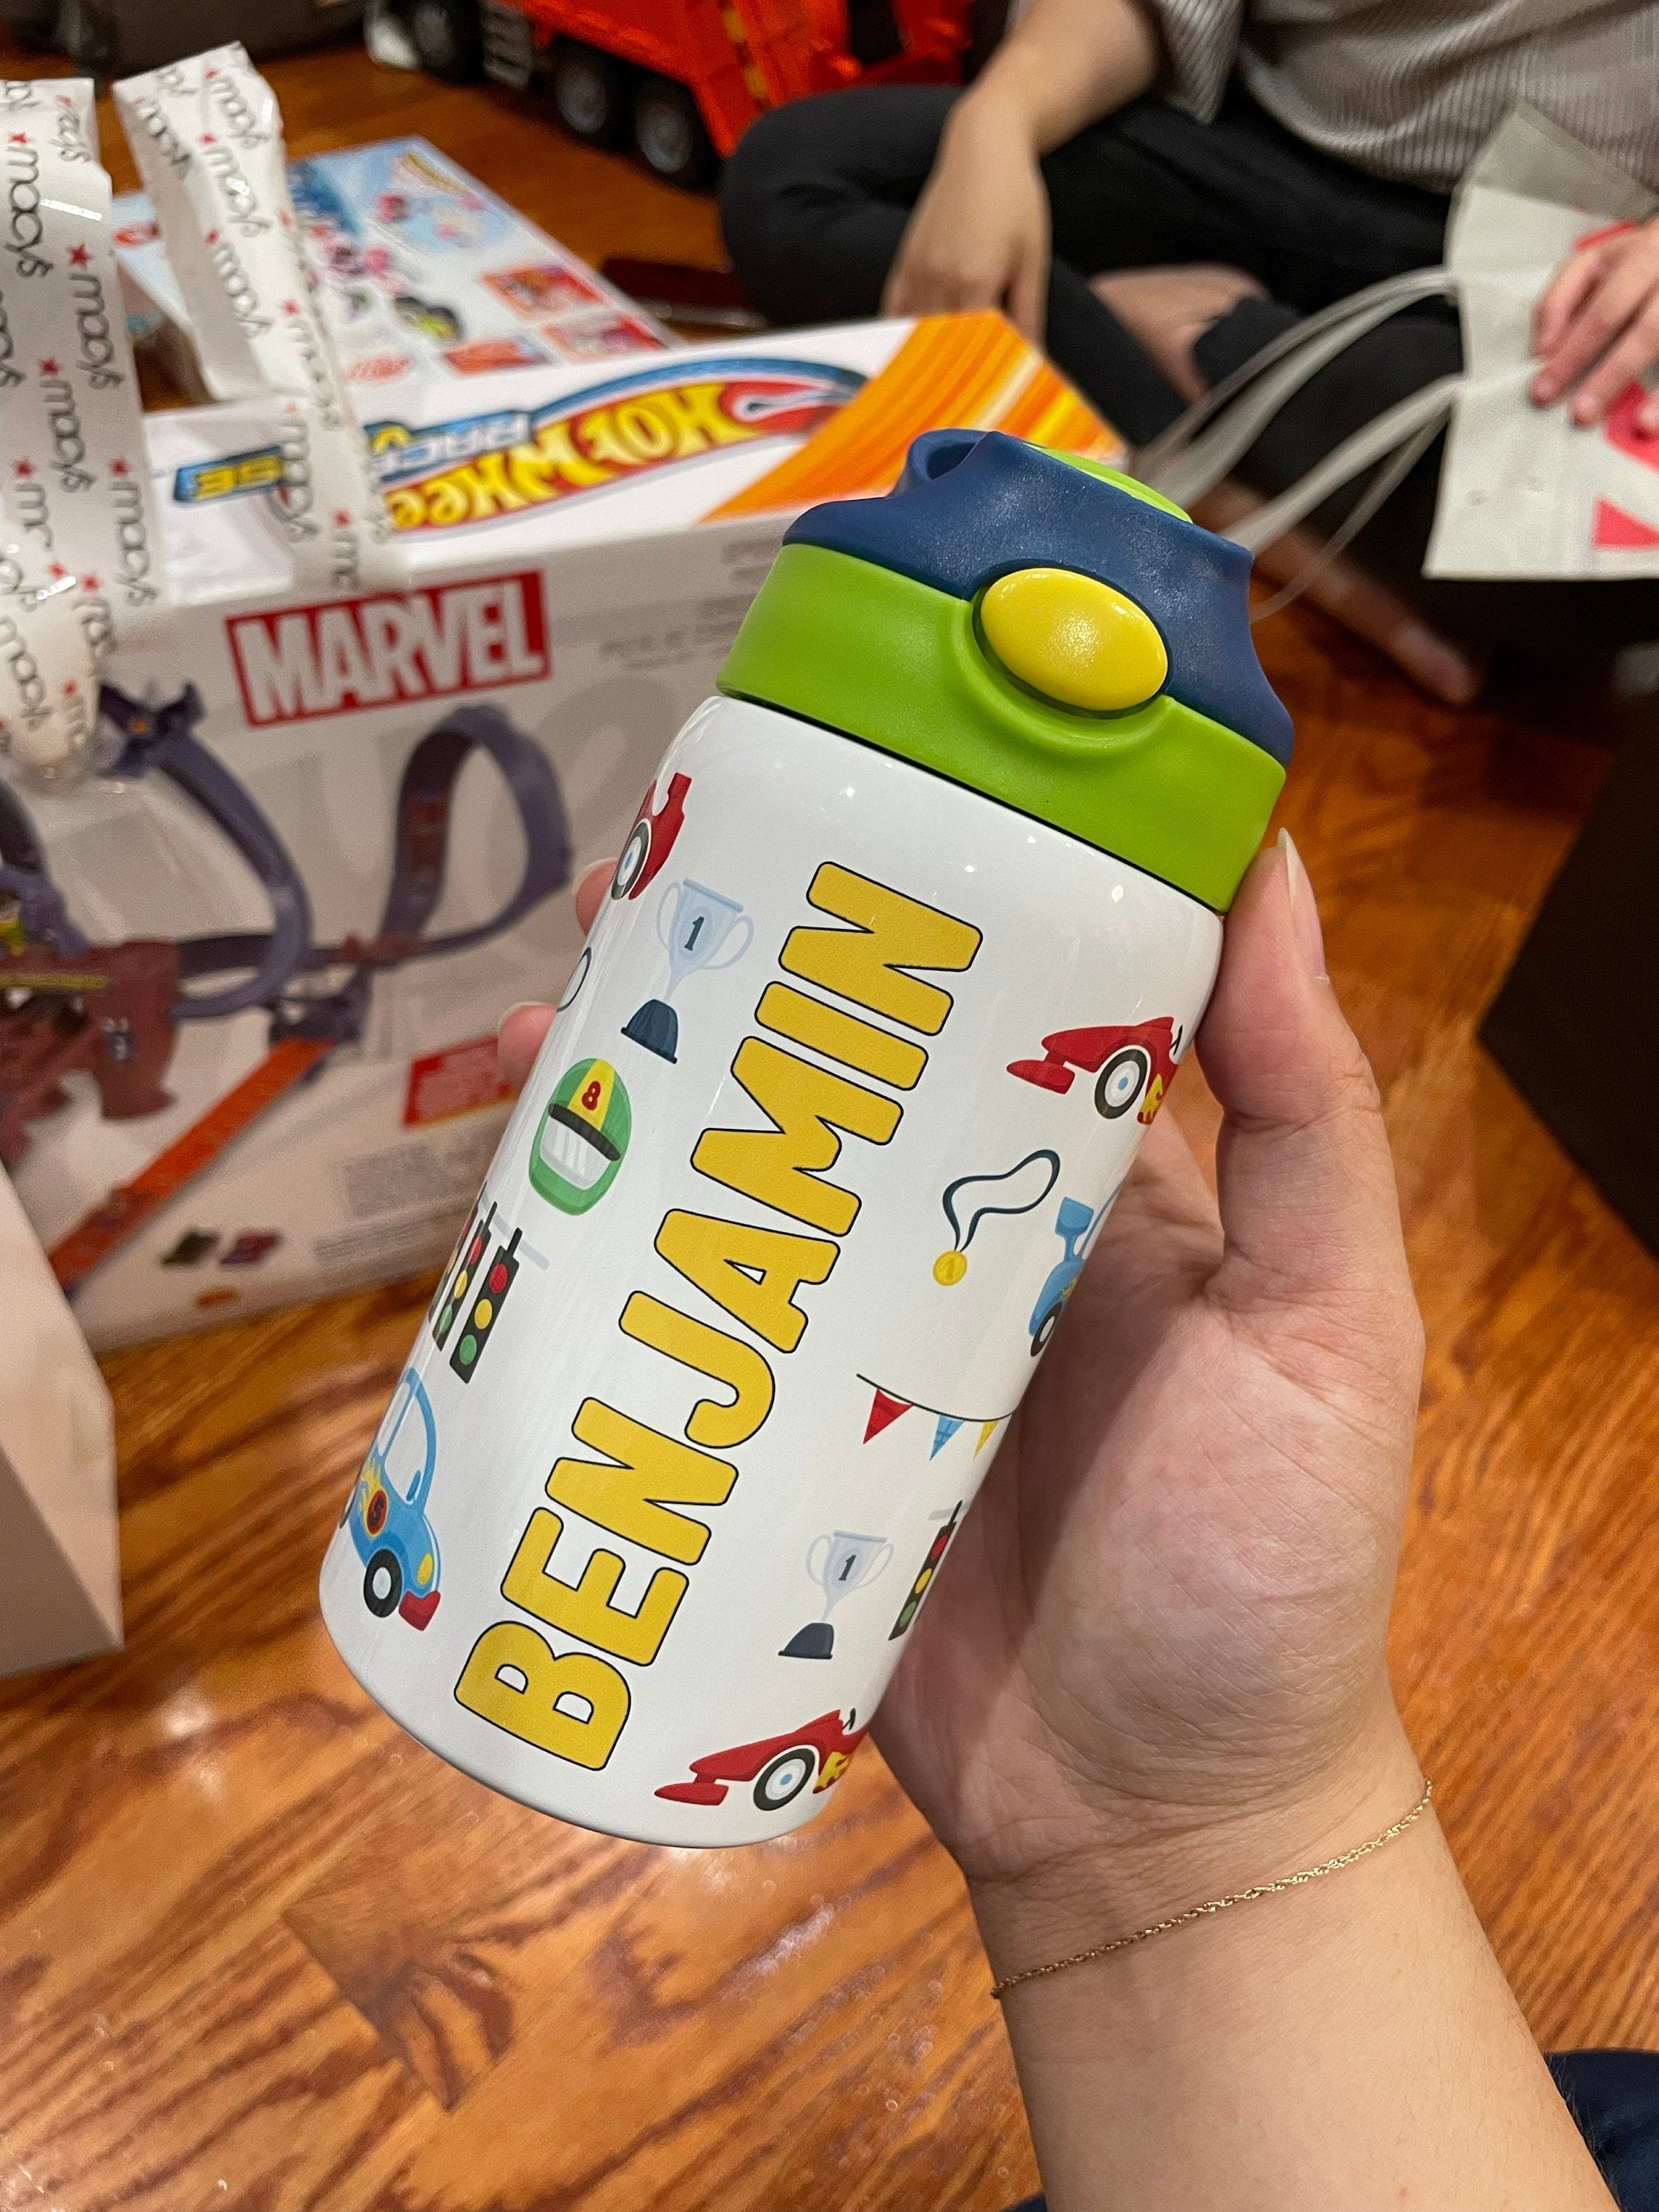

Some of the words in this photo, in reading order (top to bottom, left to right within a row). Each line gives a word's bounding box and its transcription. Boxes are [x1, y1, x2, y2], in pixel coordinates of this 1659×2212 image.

[233, 577, 546, 723] MARVEL
[684, 916, 705, 951] 1
[581, 1080, 602, 1111] 8
[453, 861, 984, 1771] BENJAMIN
[838, 1554, 857, 1582] 1
